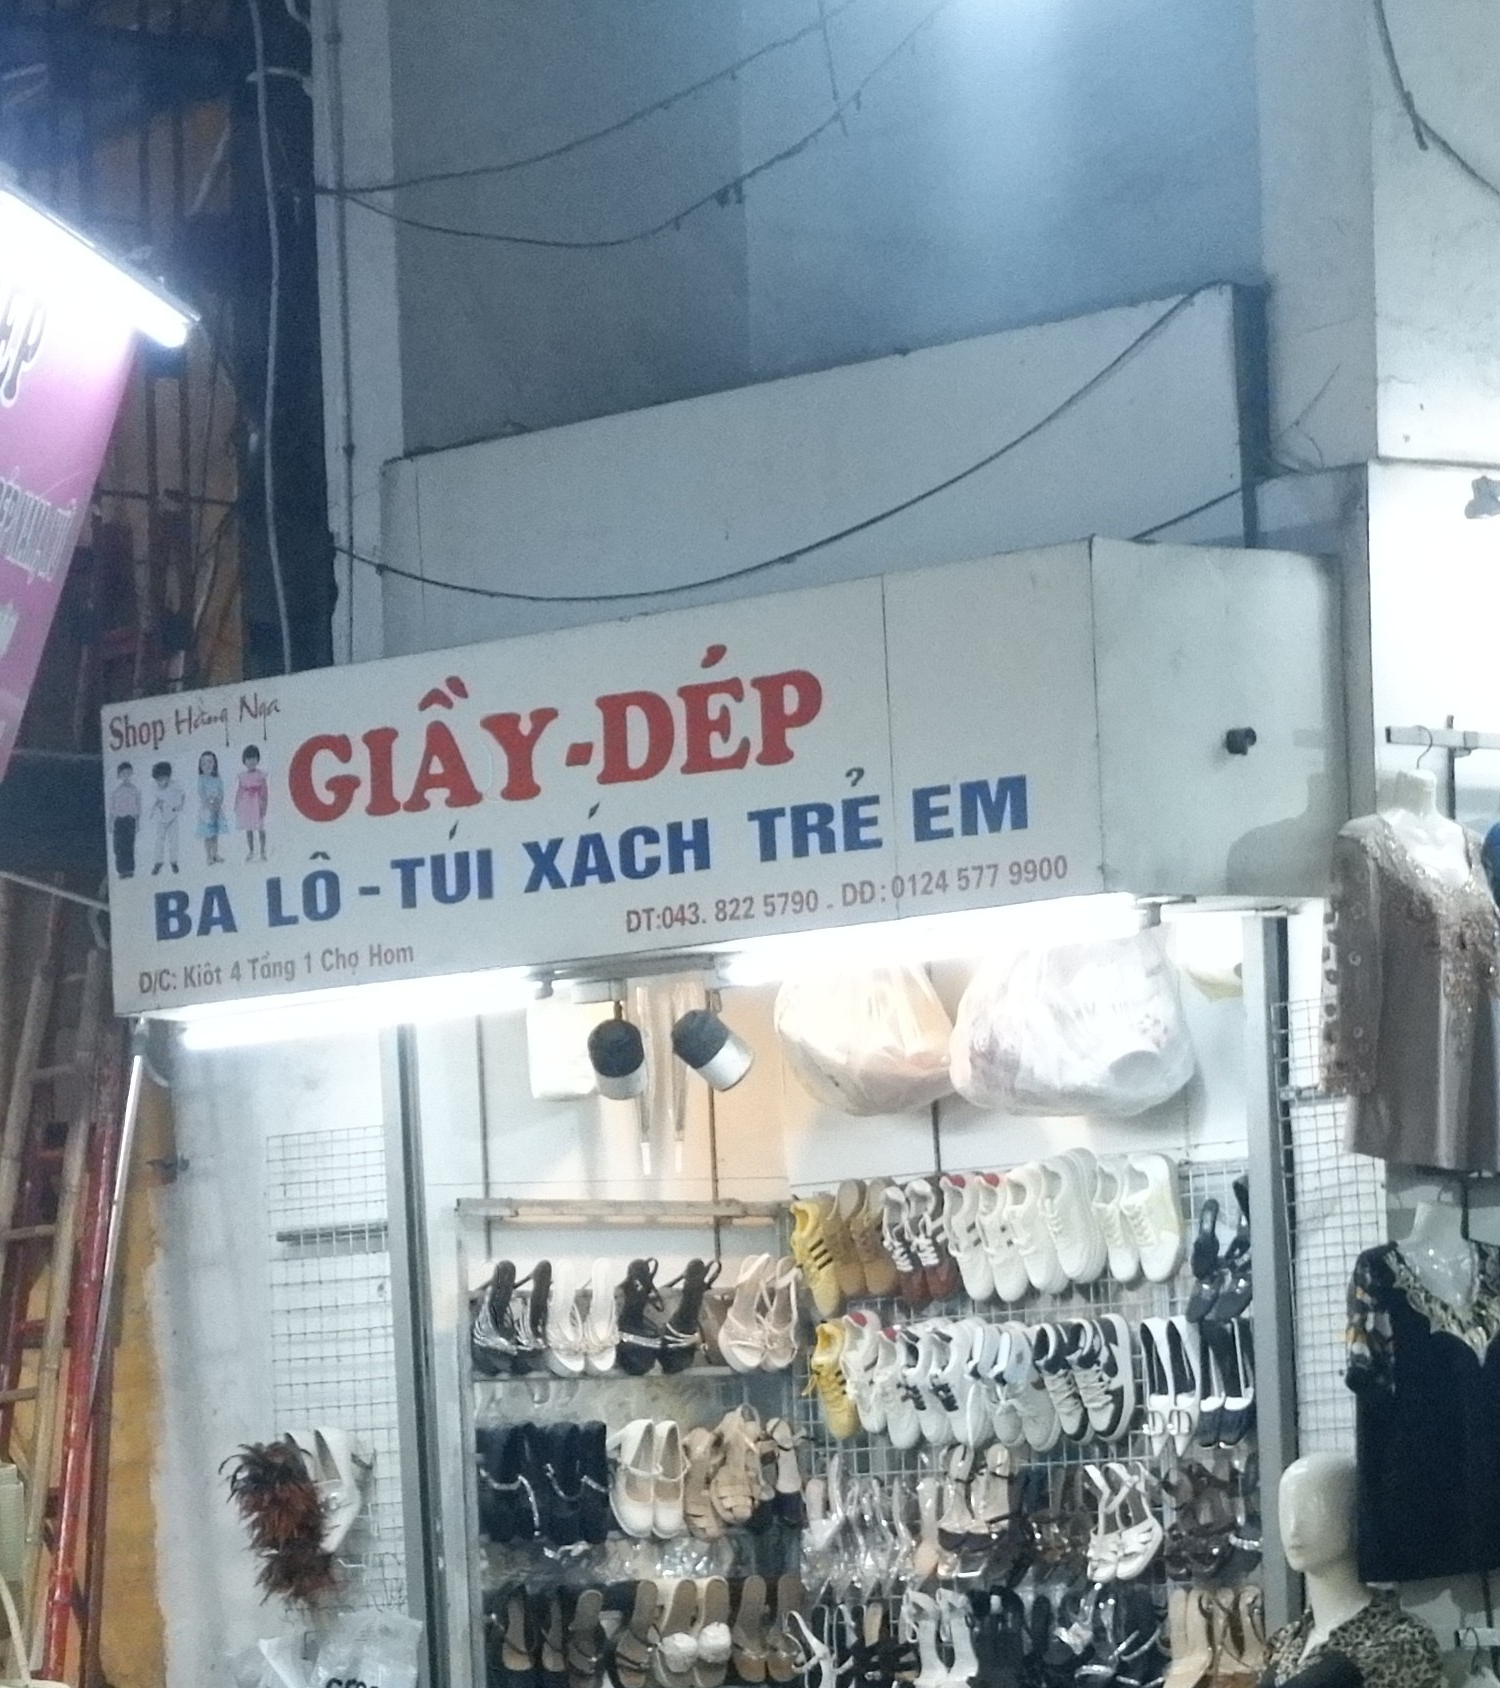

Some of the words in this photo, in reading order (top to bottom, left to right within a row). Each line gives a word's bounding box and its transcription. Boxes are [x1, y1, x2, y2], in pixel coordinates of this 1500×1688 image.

[109, 714, 165, 751] Shop
[154, 884, 239, 942] BA
[522, 802, 712, 893] XÁCH
[747, 767, 884, 863] TRẺ
[912, 774, 1030, 843] EM
[715, 897, 756, 923] 822
[763, 888, 819, 918] 5790
[957, 863, 1000, 892] 577
[1008, 854, 1069, 886] 9900
[230, 960, 243, 983] 4
[302, 954, 313, 975] 1
[320, 947, 360, 977] Chợ
